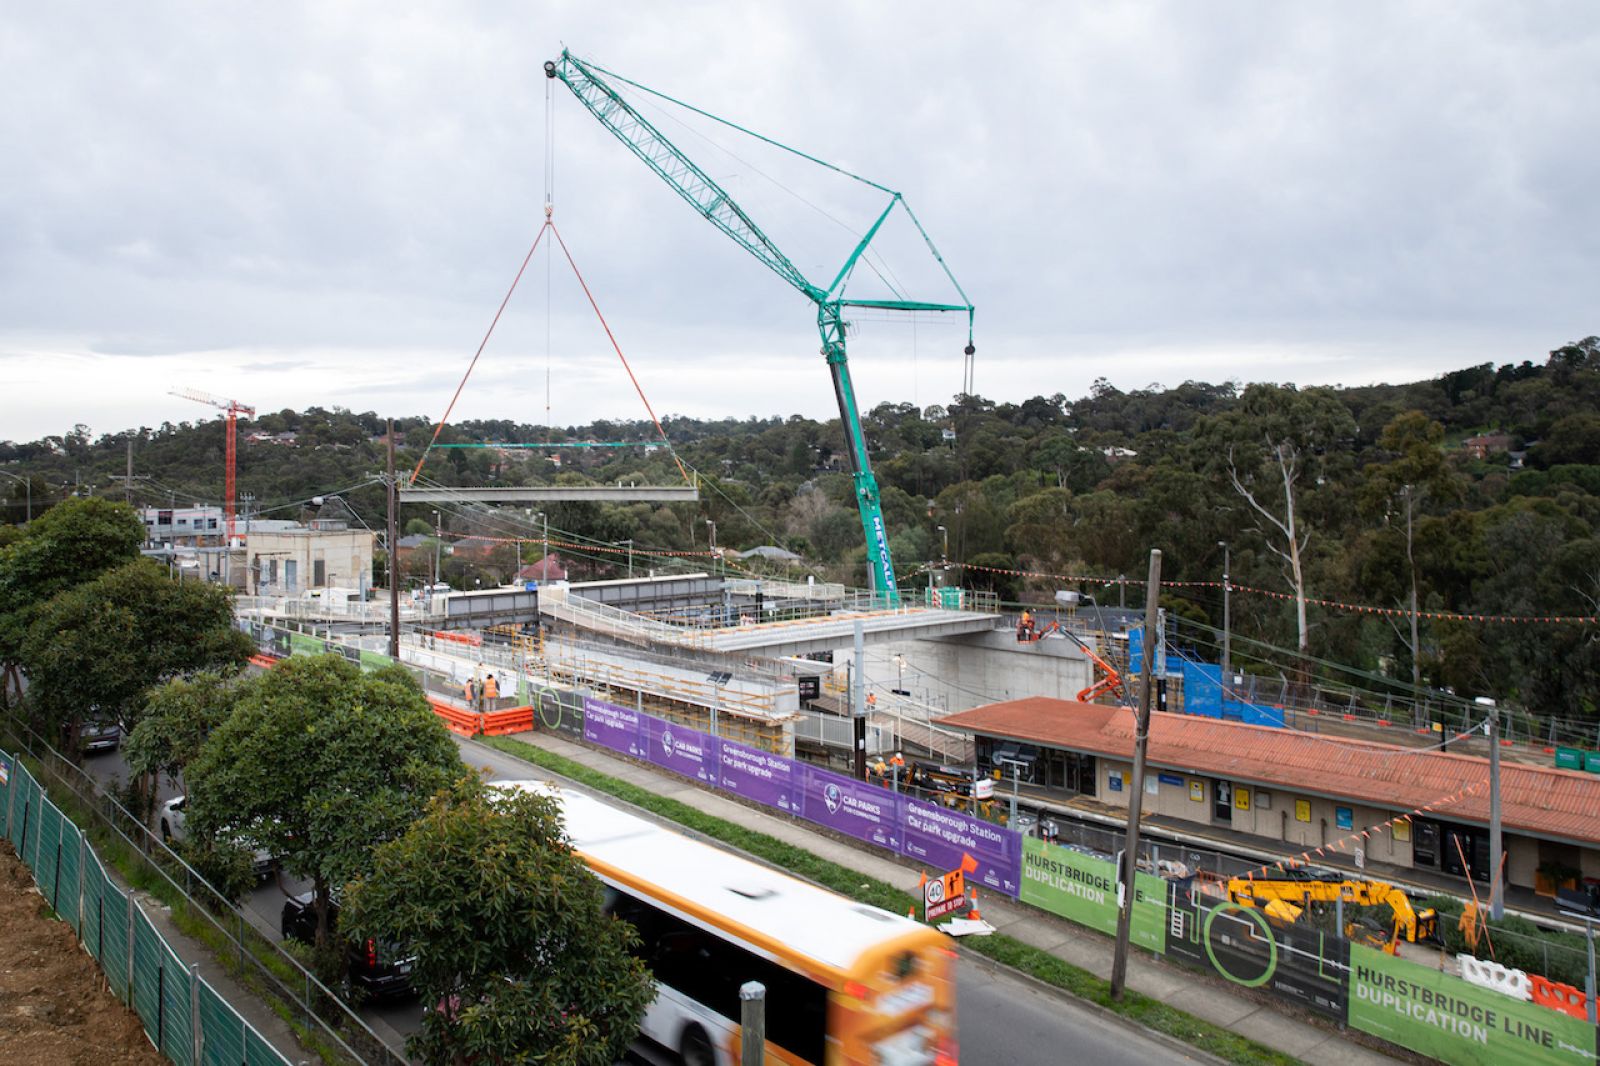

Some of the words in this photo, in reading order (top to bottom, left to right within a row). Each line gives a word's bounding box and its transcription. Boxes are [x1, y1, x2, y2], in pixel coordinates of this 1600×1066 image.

[873, 516, 893, 590] METCALF
[723, 743, 766, 766] Greensborough
[767, 757, 790, 773] Station
[723, 755, 734, 766] Car
[734, 758, 747, 772] park
[747, 764, 772, 779] upgrade
[843, 795, 857, 807] CAR
[858, 800, 881, 815] PARKS
[908, 802, 968, 831] Greensborough
[969, 823, 1002, 843] Station
[908, 815, 921, 827] Car
[922, 820, 942, 836] park
[942, 829, 977, 848] upgrade
[930, 885, 941, 897] 40
[1025, 852, 1110, 891] HURSTBRIDGE
[1025, 866, 1105, 905] DUPLICATION
[1356, 982, 1488, 1045] DUPLICATION
[1357, 965, 1497, 1029] HURSTBRIDGE
[1504, 1016, 1554, 1049] LINE
